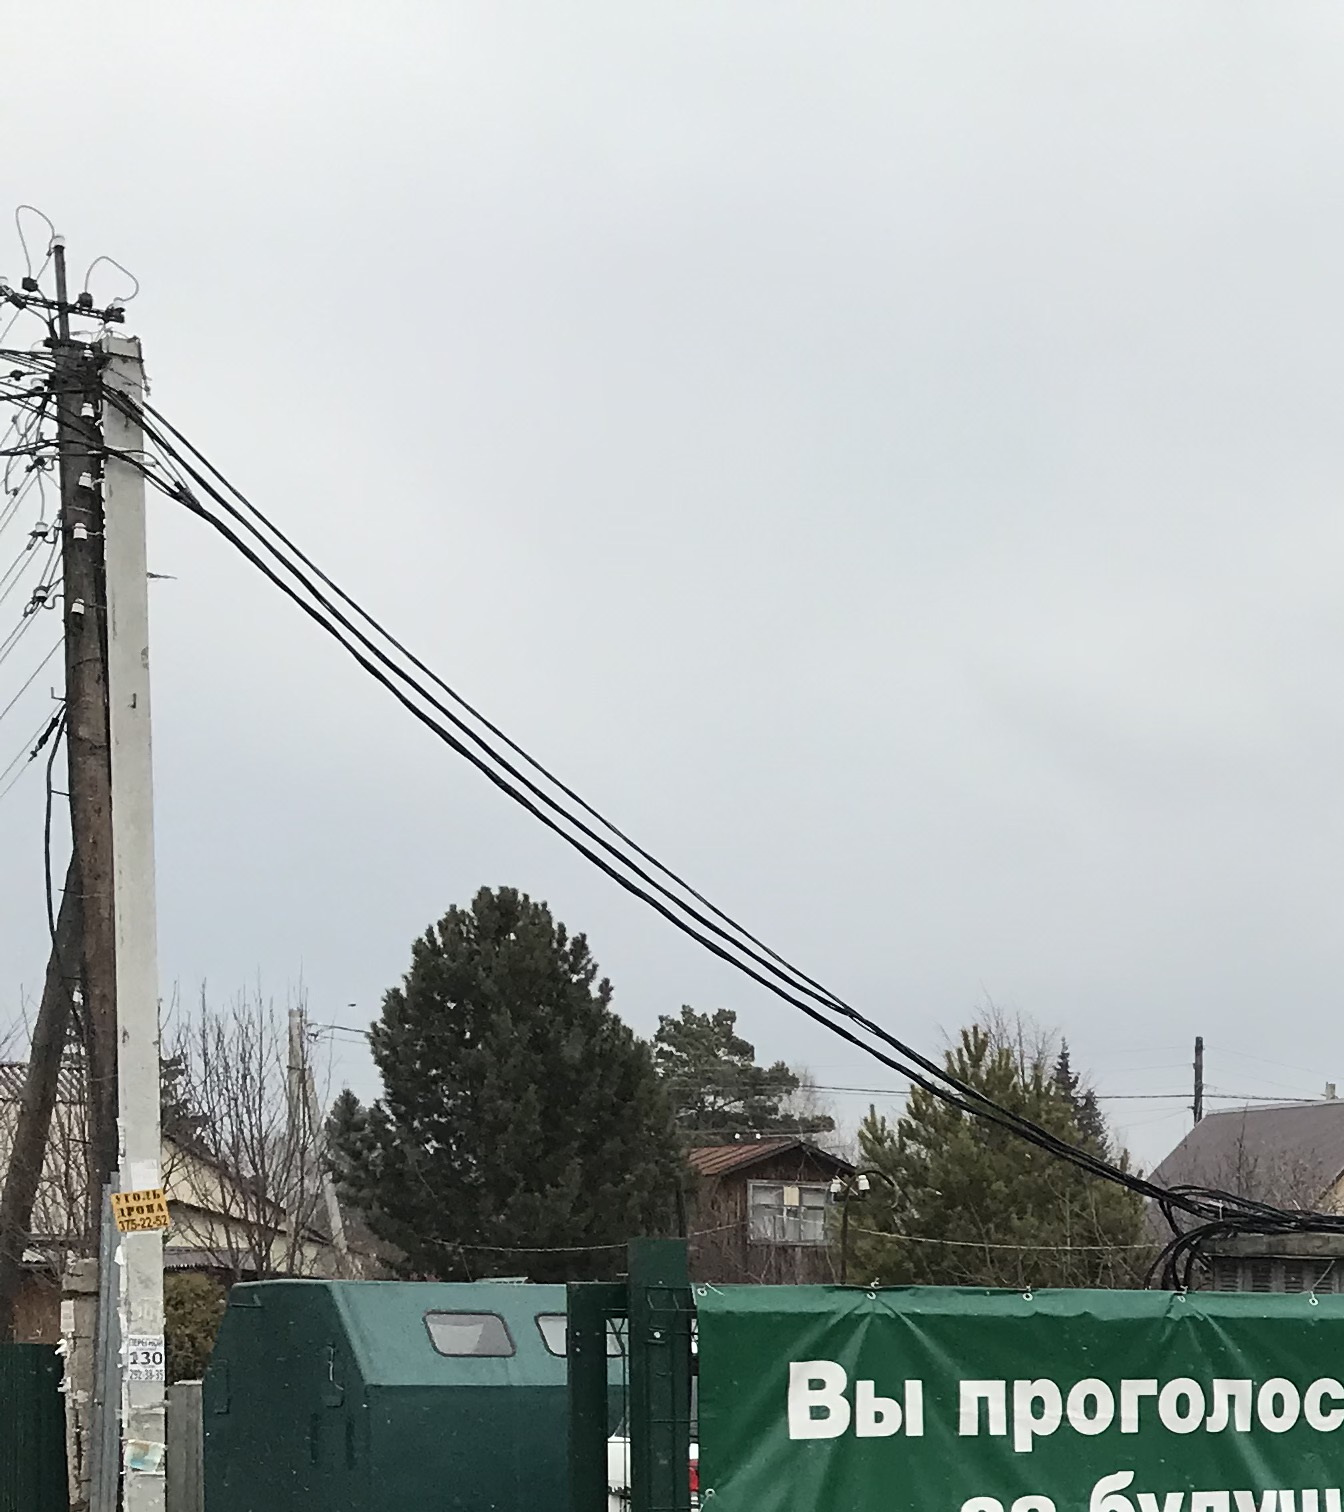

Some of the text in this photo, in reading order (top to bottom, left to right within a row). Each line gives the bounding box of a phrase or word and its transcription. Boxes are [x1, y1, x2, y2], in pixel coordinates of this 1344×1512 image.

[119, 1215, 168, 1232] 375-22-52
[129, 1352, 163, 1365] 130
[788, 1361, 923, 1439] Вы
